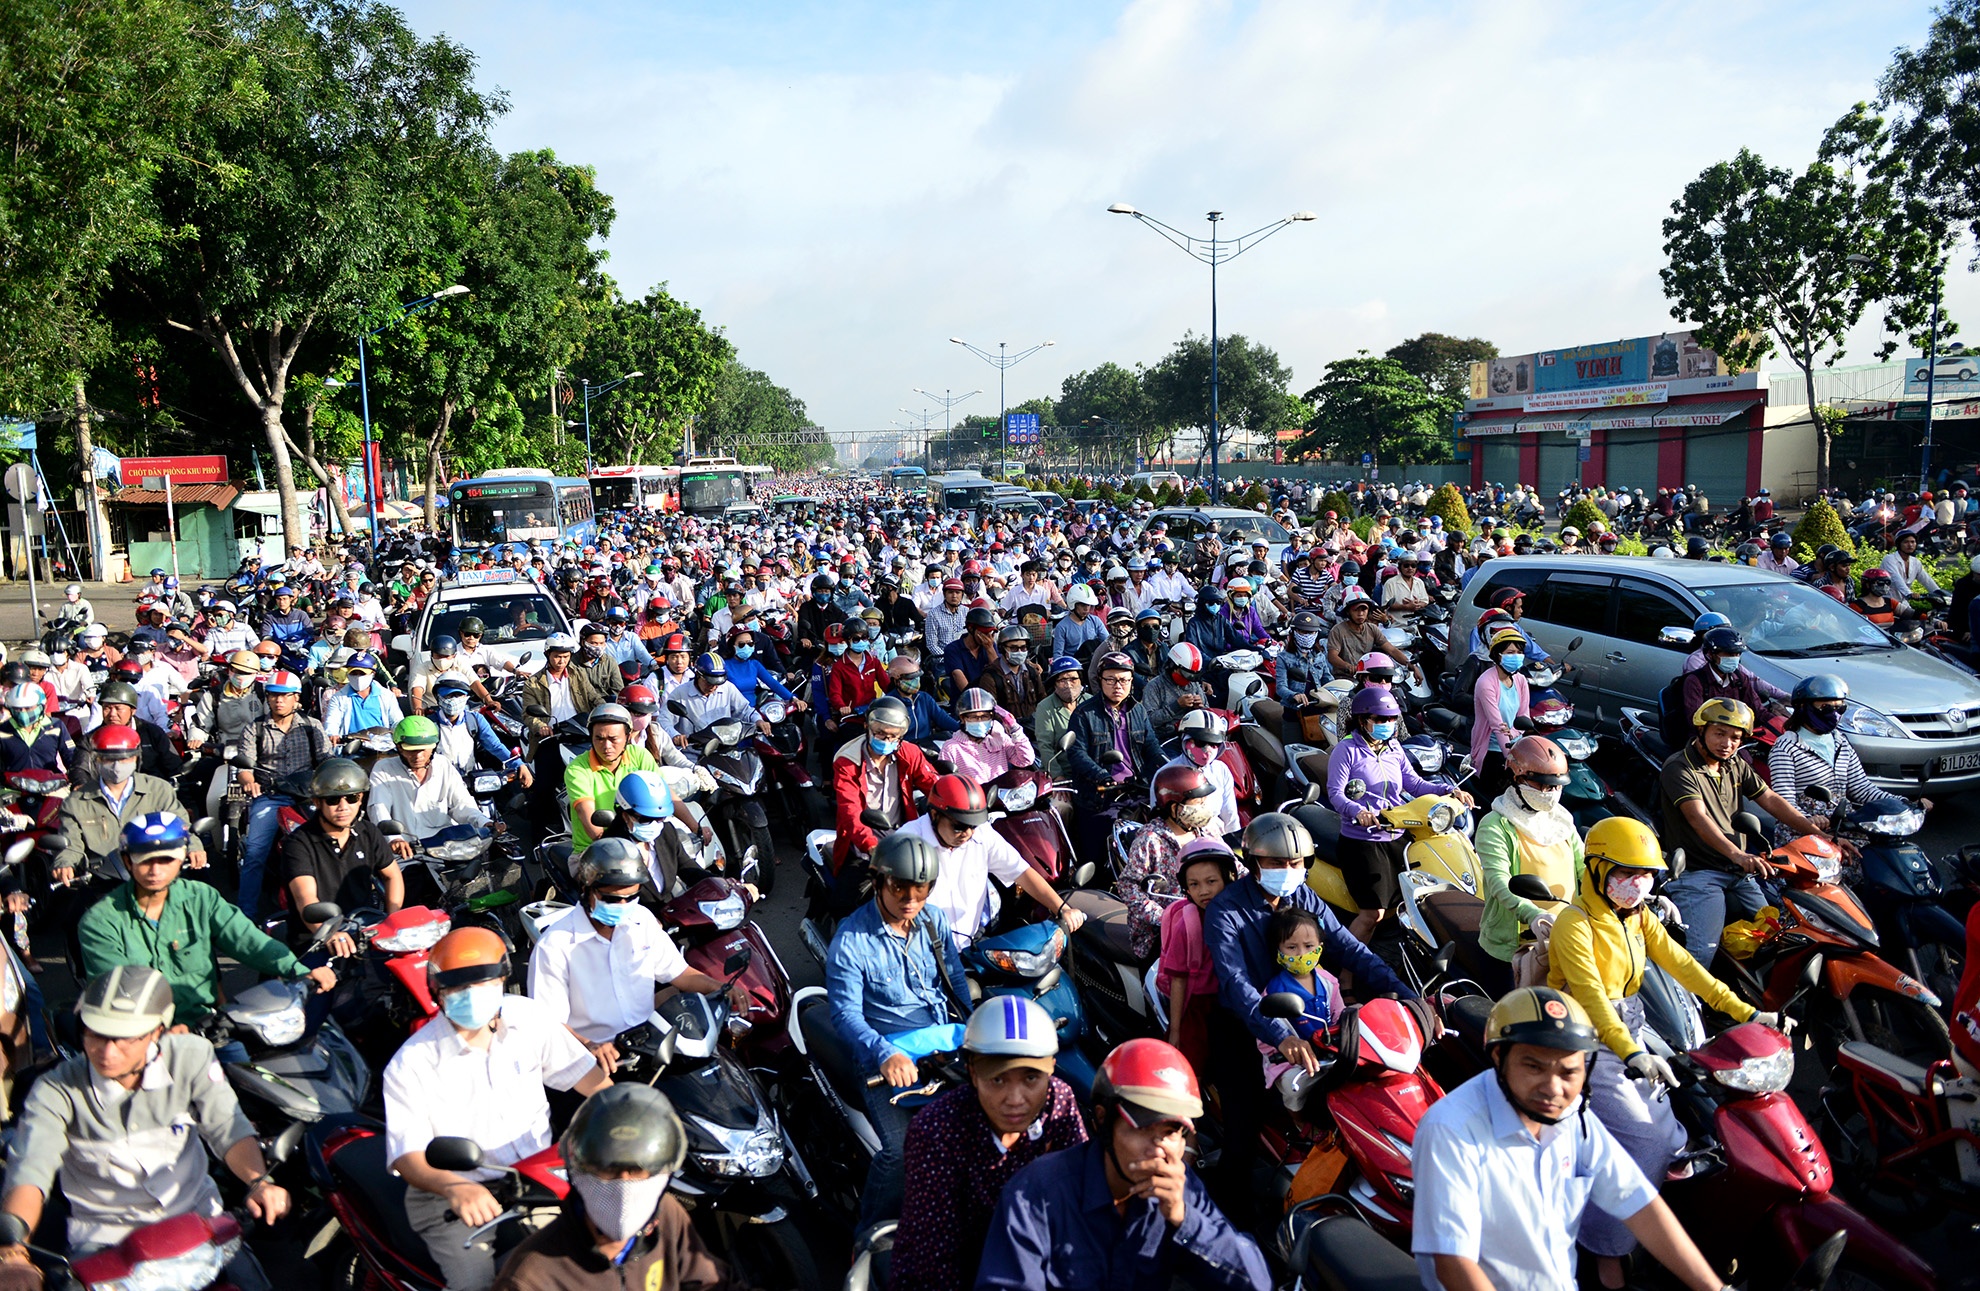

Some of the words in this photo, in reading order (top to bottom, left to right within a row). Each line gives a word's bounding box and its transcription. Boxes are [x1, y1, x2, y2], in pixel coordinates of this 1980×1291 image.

[1575, 356, 1623, 379] VINH
[1610, 418, 1635, 428] VINH
[1691, 415, 1721, 424] VINH
[1485, 425, 1503, 434] VINH
[1543, 422, 1564, 431] VINH
[128, 468, 147, 477] CHỐT
[148, 467, 162, 476] DÂN
[164, 466, 186, 475] PHÒNG
[202, 466, 216, 474] PHỐ
[461, 572, 482, 580] TAXI
[1966, 753, 1980, 768] 32
[1399, 1085, 1421, 1095] HONDA
